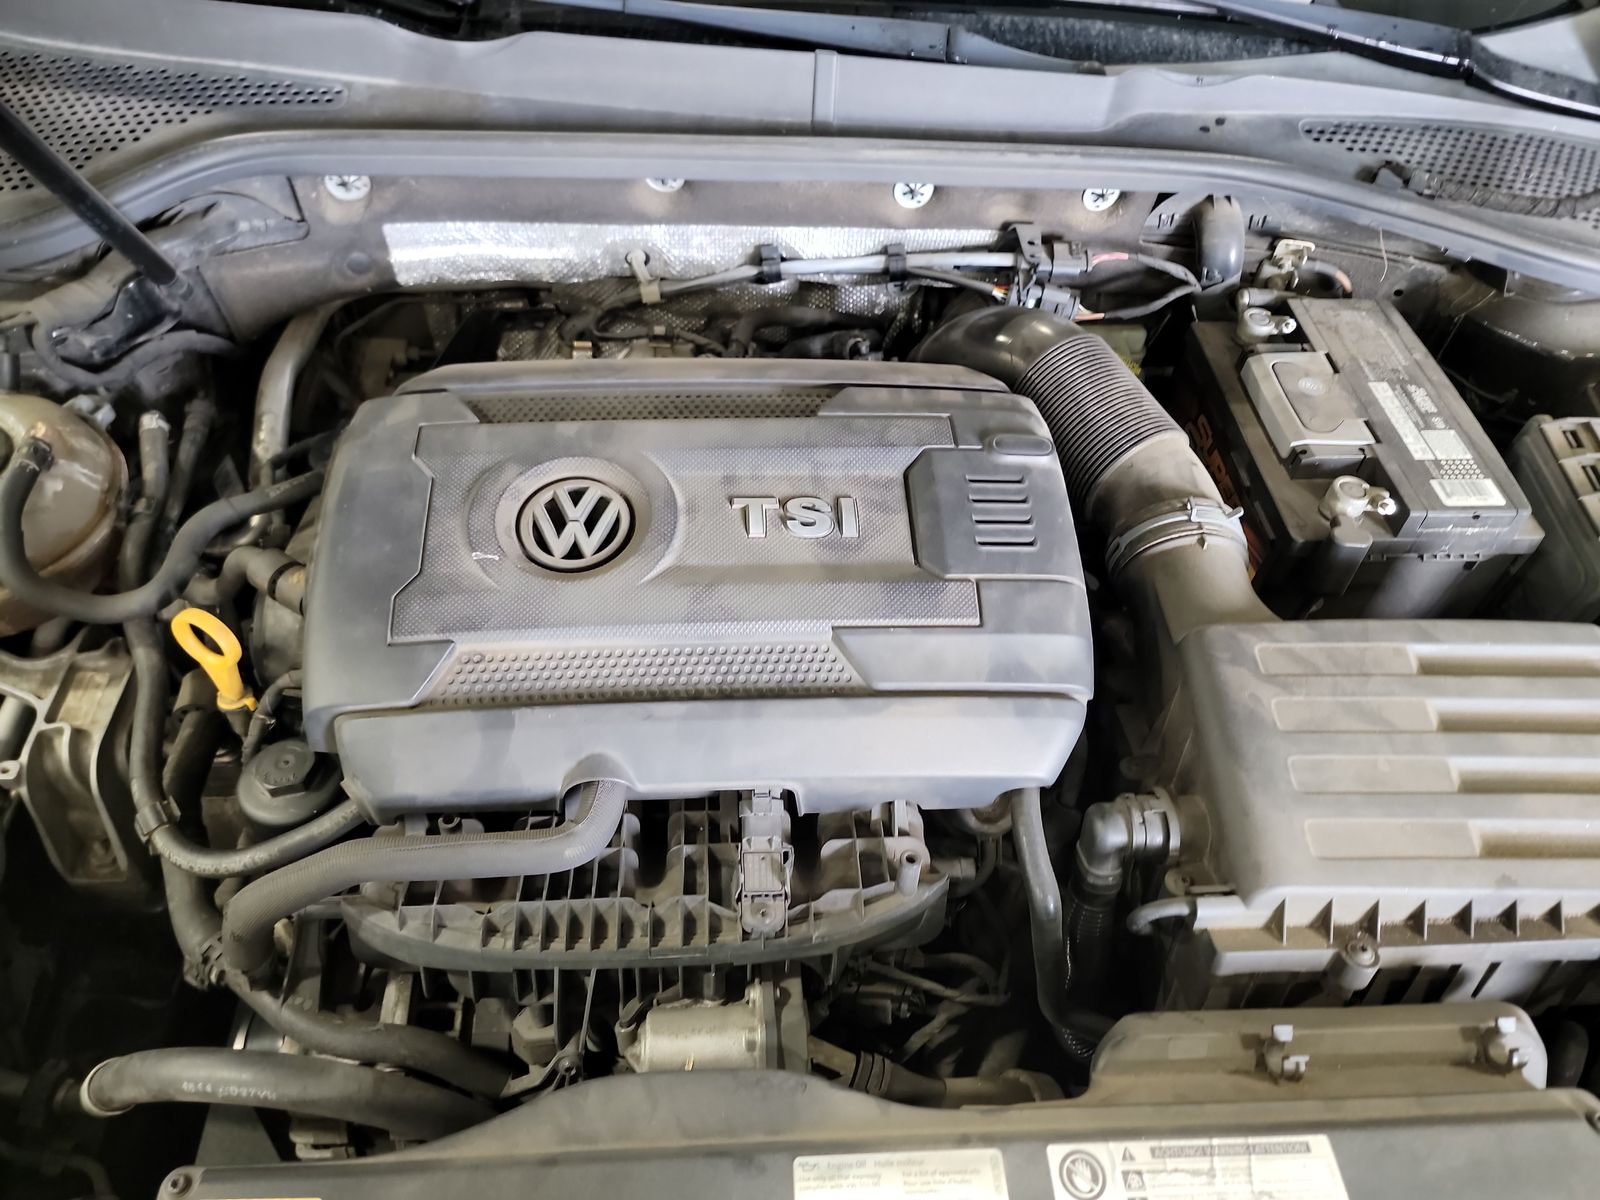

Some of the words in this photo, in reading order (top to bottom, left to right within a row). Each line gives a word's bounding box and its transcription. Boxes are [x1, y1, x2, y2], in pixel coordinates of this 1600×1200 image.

[530, 483, 622, 561] VW
[731, 495, 861, 539] TSI
[827, 1161, 853, 1171] Engine
